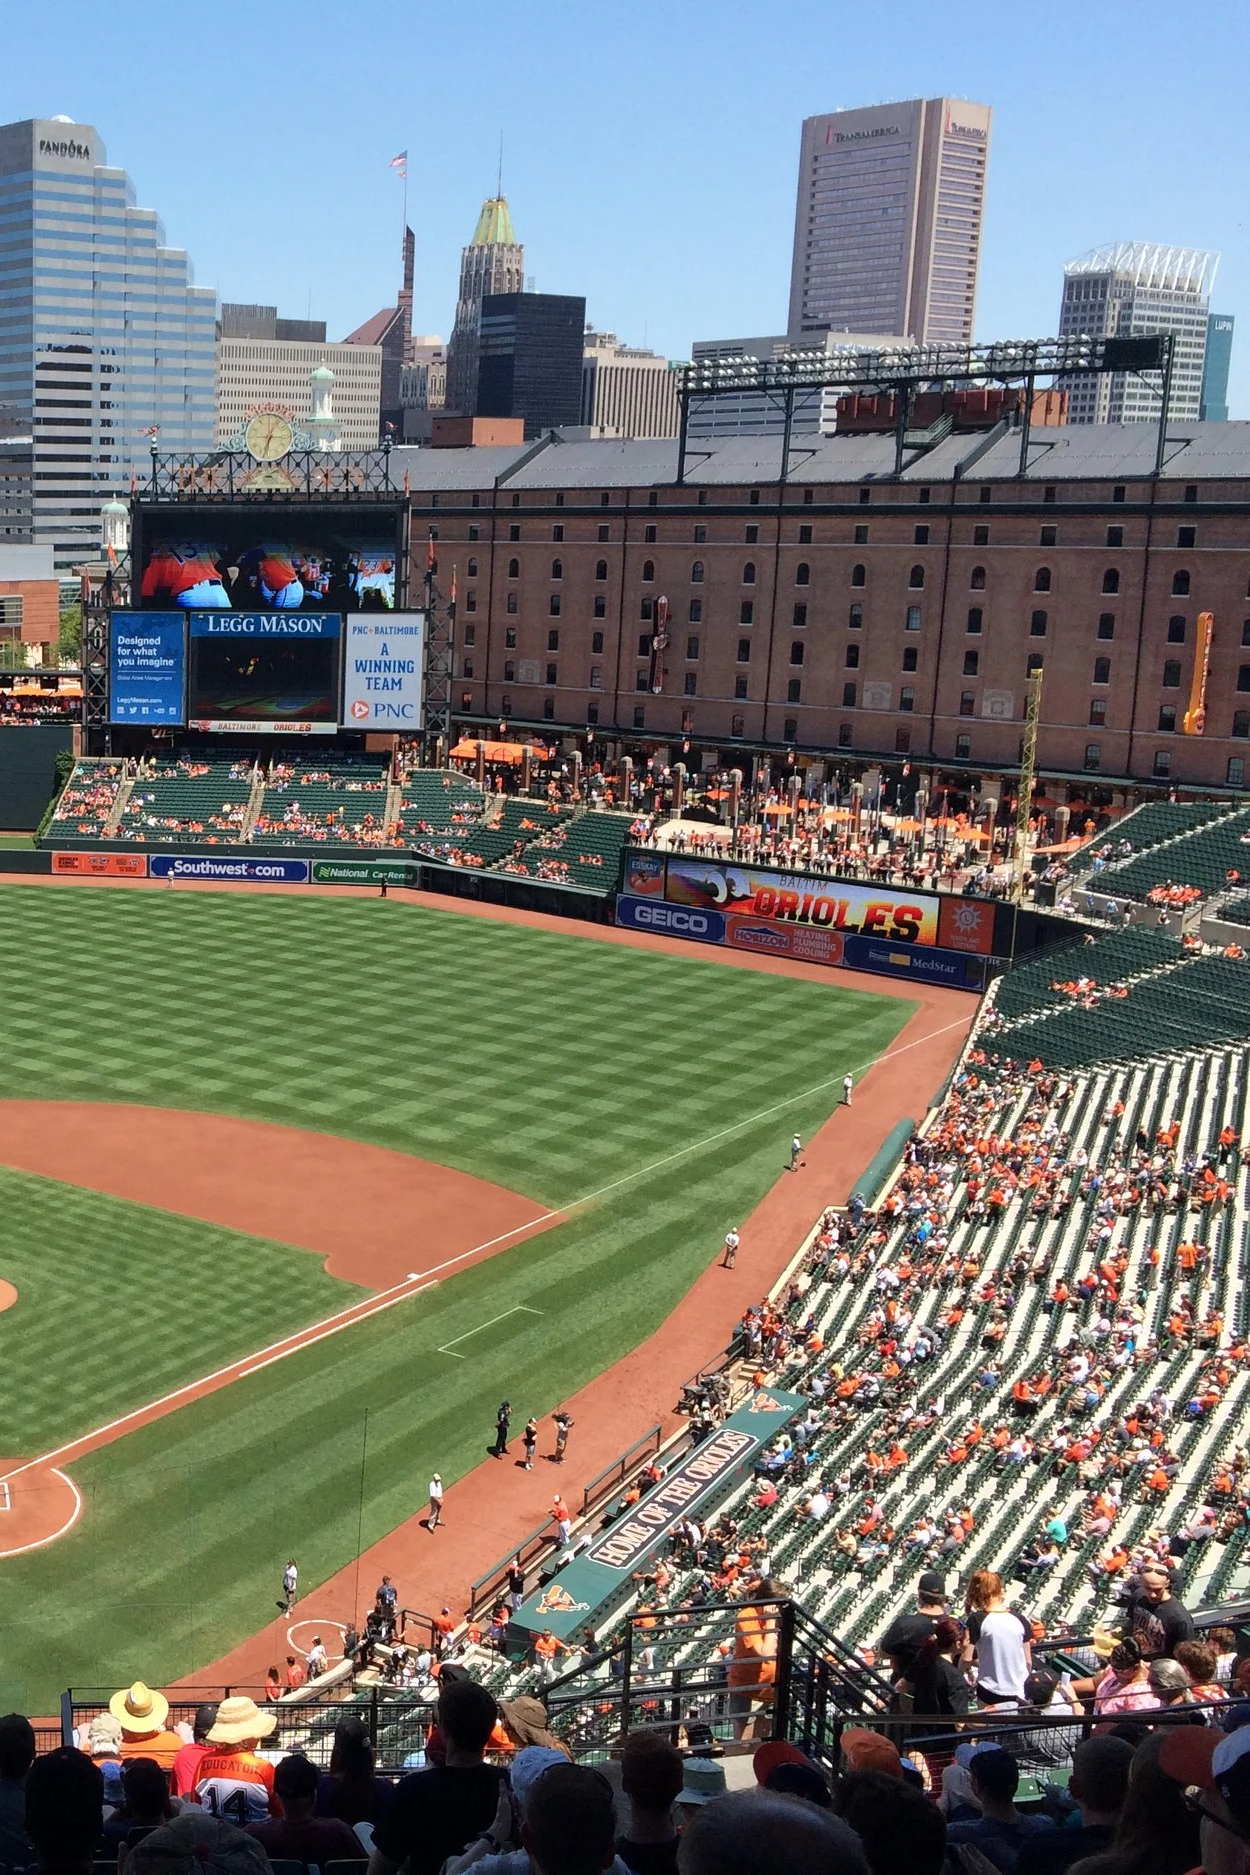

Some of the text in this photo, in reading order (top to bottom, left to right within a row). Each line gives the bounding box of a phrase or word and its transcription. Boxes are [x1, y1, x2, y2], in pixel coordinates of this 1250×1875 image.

[40, 140, 90, 156] PANDORA
[207, 615, 323, 633] LEGG MASON
[352, 626, 419, 636] PNC BALTIMORE
[117, 636, 161, 647] Designed
[117, 646, 157, 656] for what
[380, 643, 389, 656] A
[117, 657, 175, 668] you imagine
[355, 660, 415, 673] WINNING
[365, 677, 403, 691] TEAM
[374, 703, 414, 719] PNC
[217, 722, 312, 732] BALTIMORE ORIOLES
[631, 860, 658, 872] ESSKAY
[330, 867, 369, 878] National
[372, 870, 387, 879] Car
[634, 905, 708, 933] GEICO
[753, 886, 923, 943] ORIOLES
[734, 929, 788, 948] HORIZON
[793, 928, 831, 941] HEATING
[792, 937, 837, 952] PLUMBING
[792, 946, 830, 958] COOLING
[911, 957, 957, 974] MedStar
[595, 1431, 751, 1566] HOME OF THE ORIOLES
[206, 1784, 248, 1825] 14
